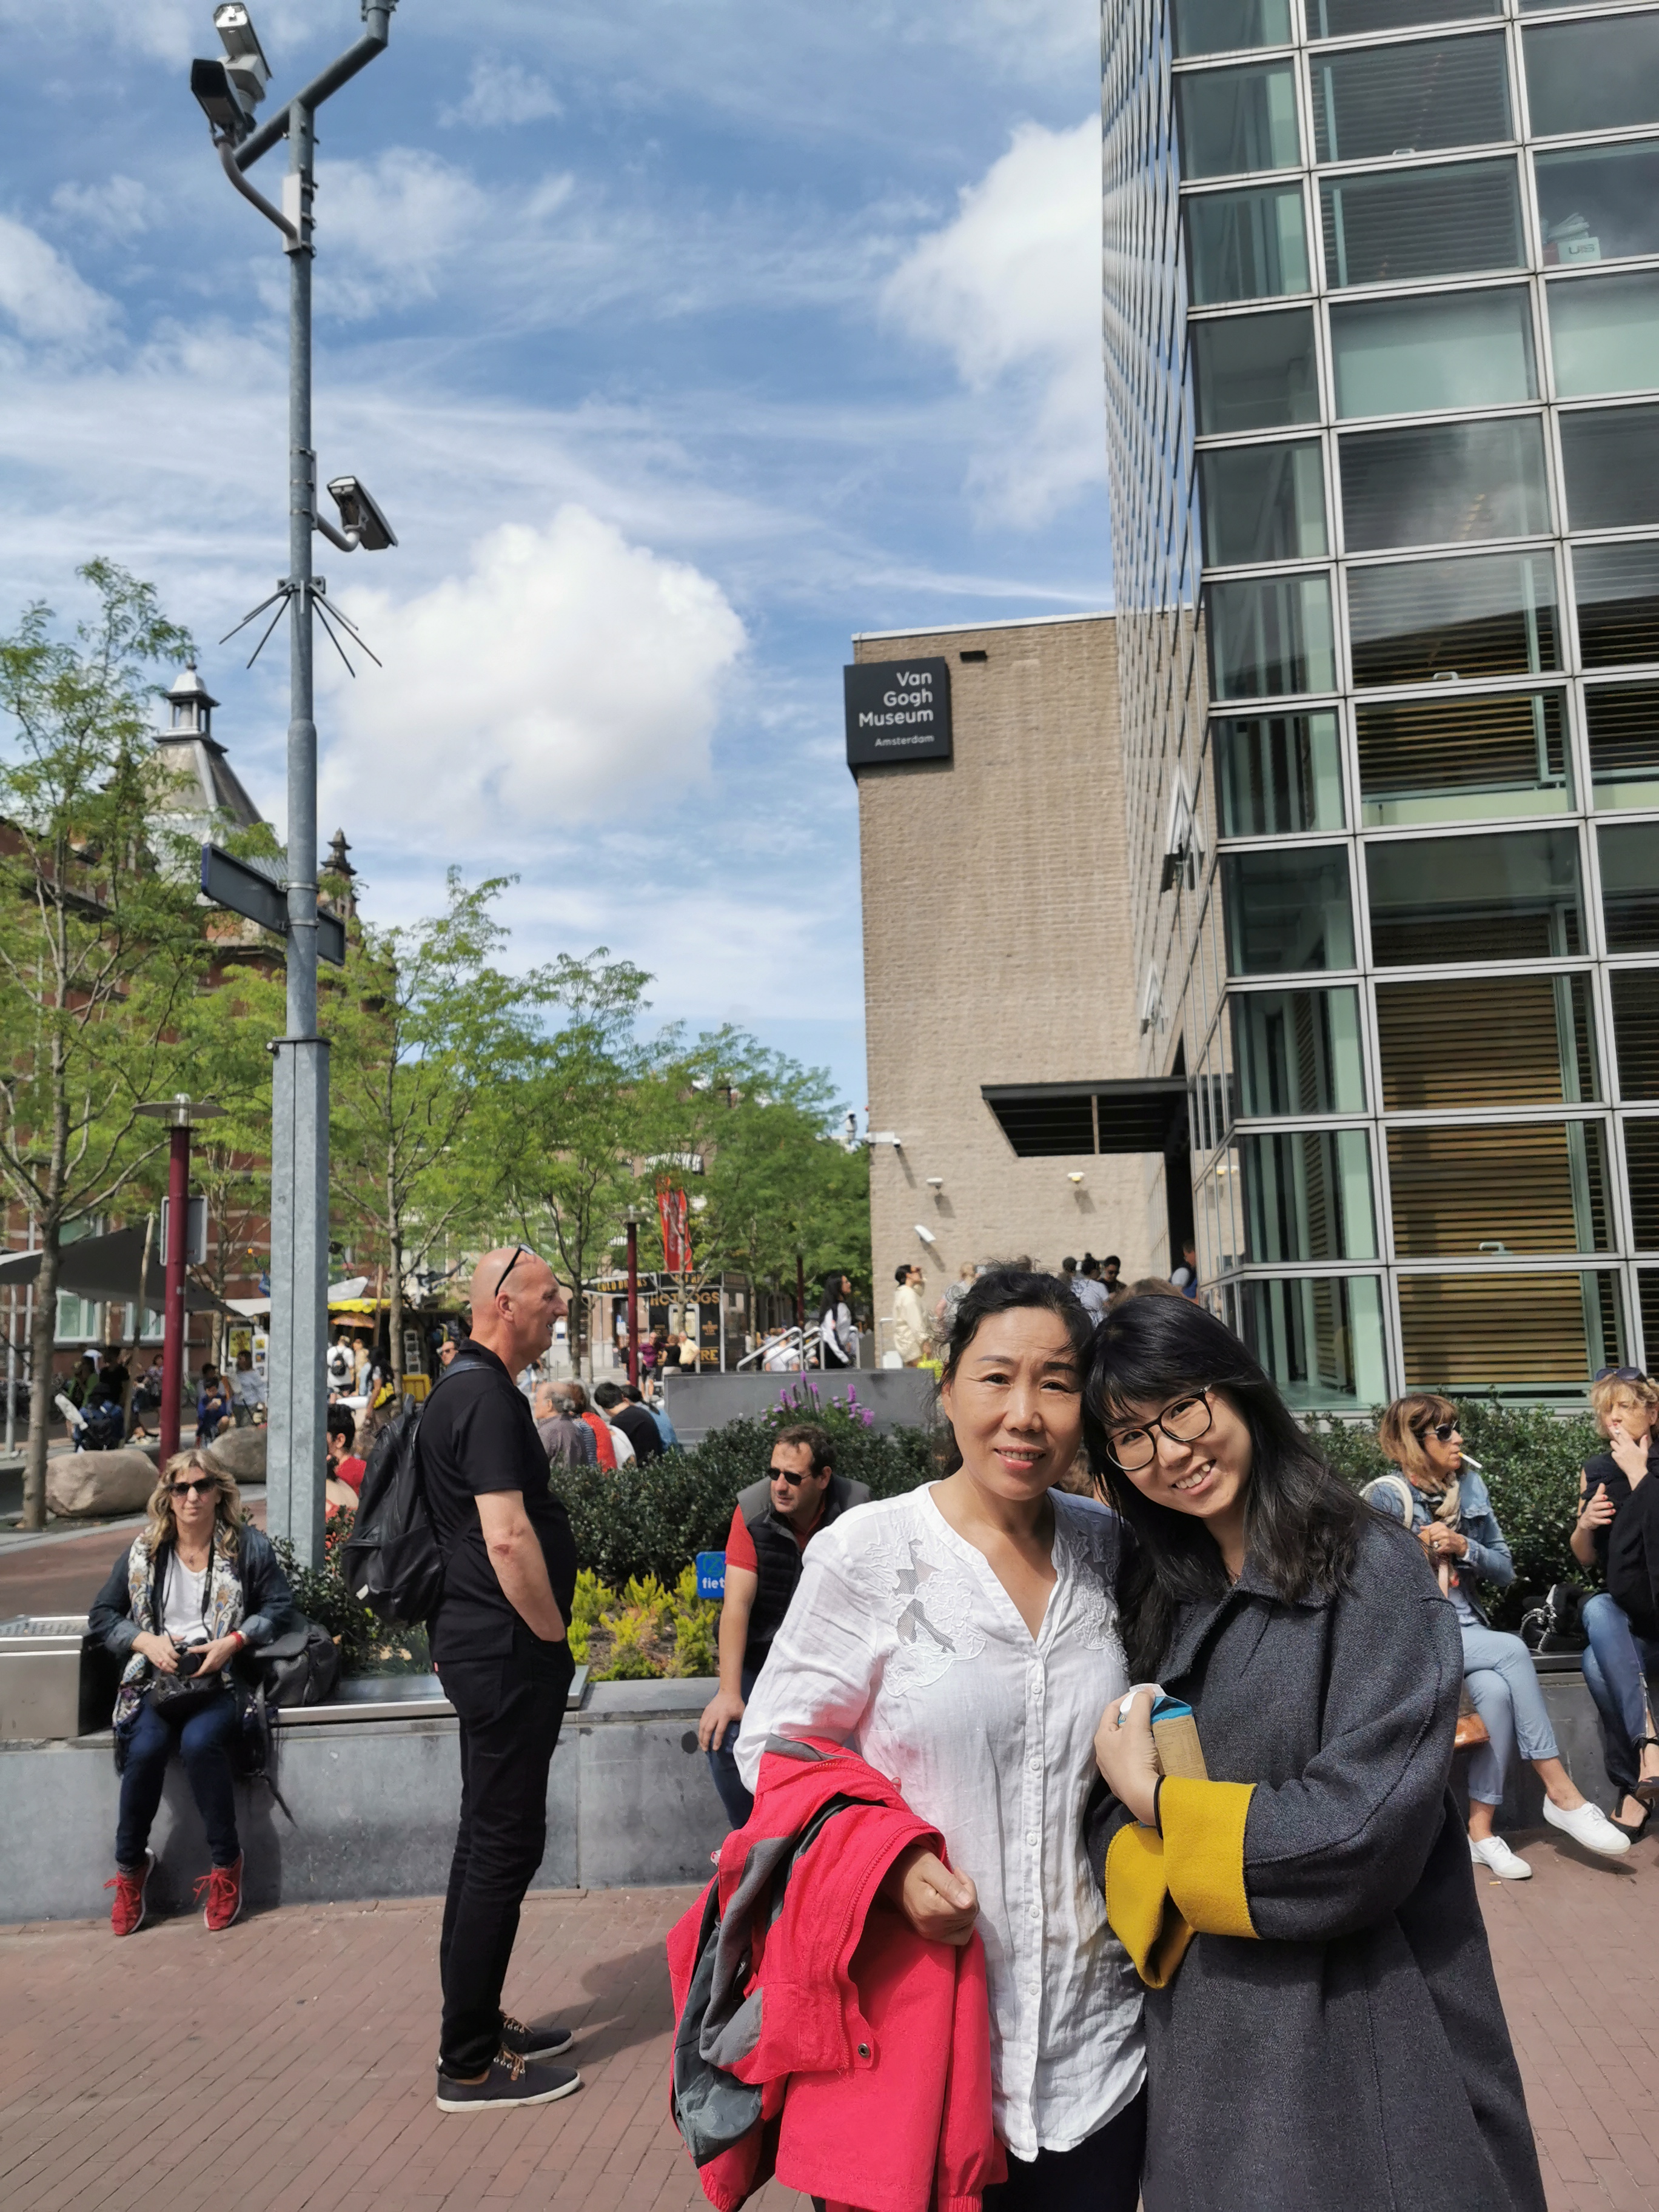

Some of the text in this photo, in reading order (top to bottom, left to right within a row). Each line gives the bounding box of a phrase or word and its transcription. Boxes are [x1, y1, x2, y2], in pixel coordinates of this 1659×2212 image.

[896, 671, 933, 686] Van
[883, 688, 933, 707] Gogh
[859, 709, 934, 728] Museum
[874, 735, 935, 747] Amsterdam
[618, 1278, 647, 1290] DRKS
[682, 1291, 720, 1304] OGS
